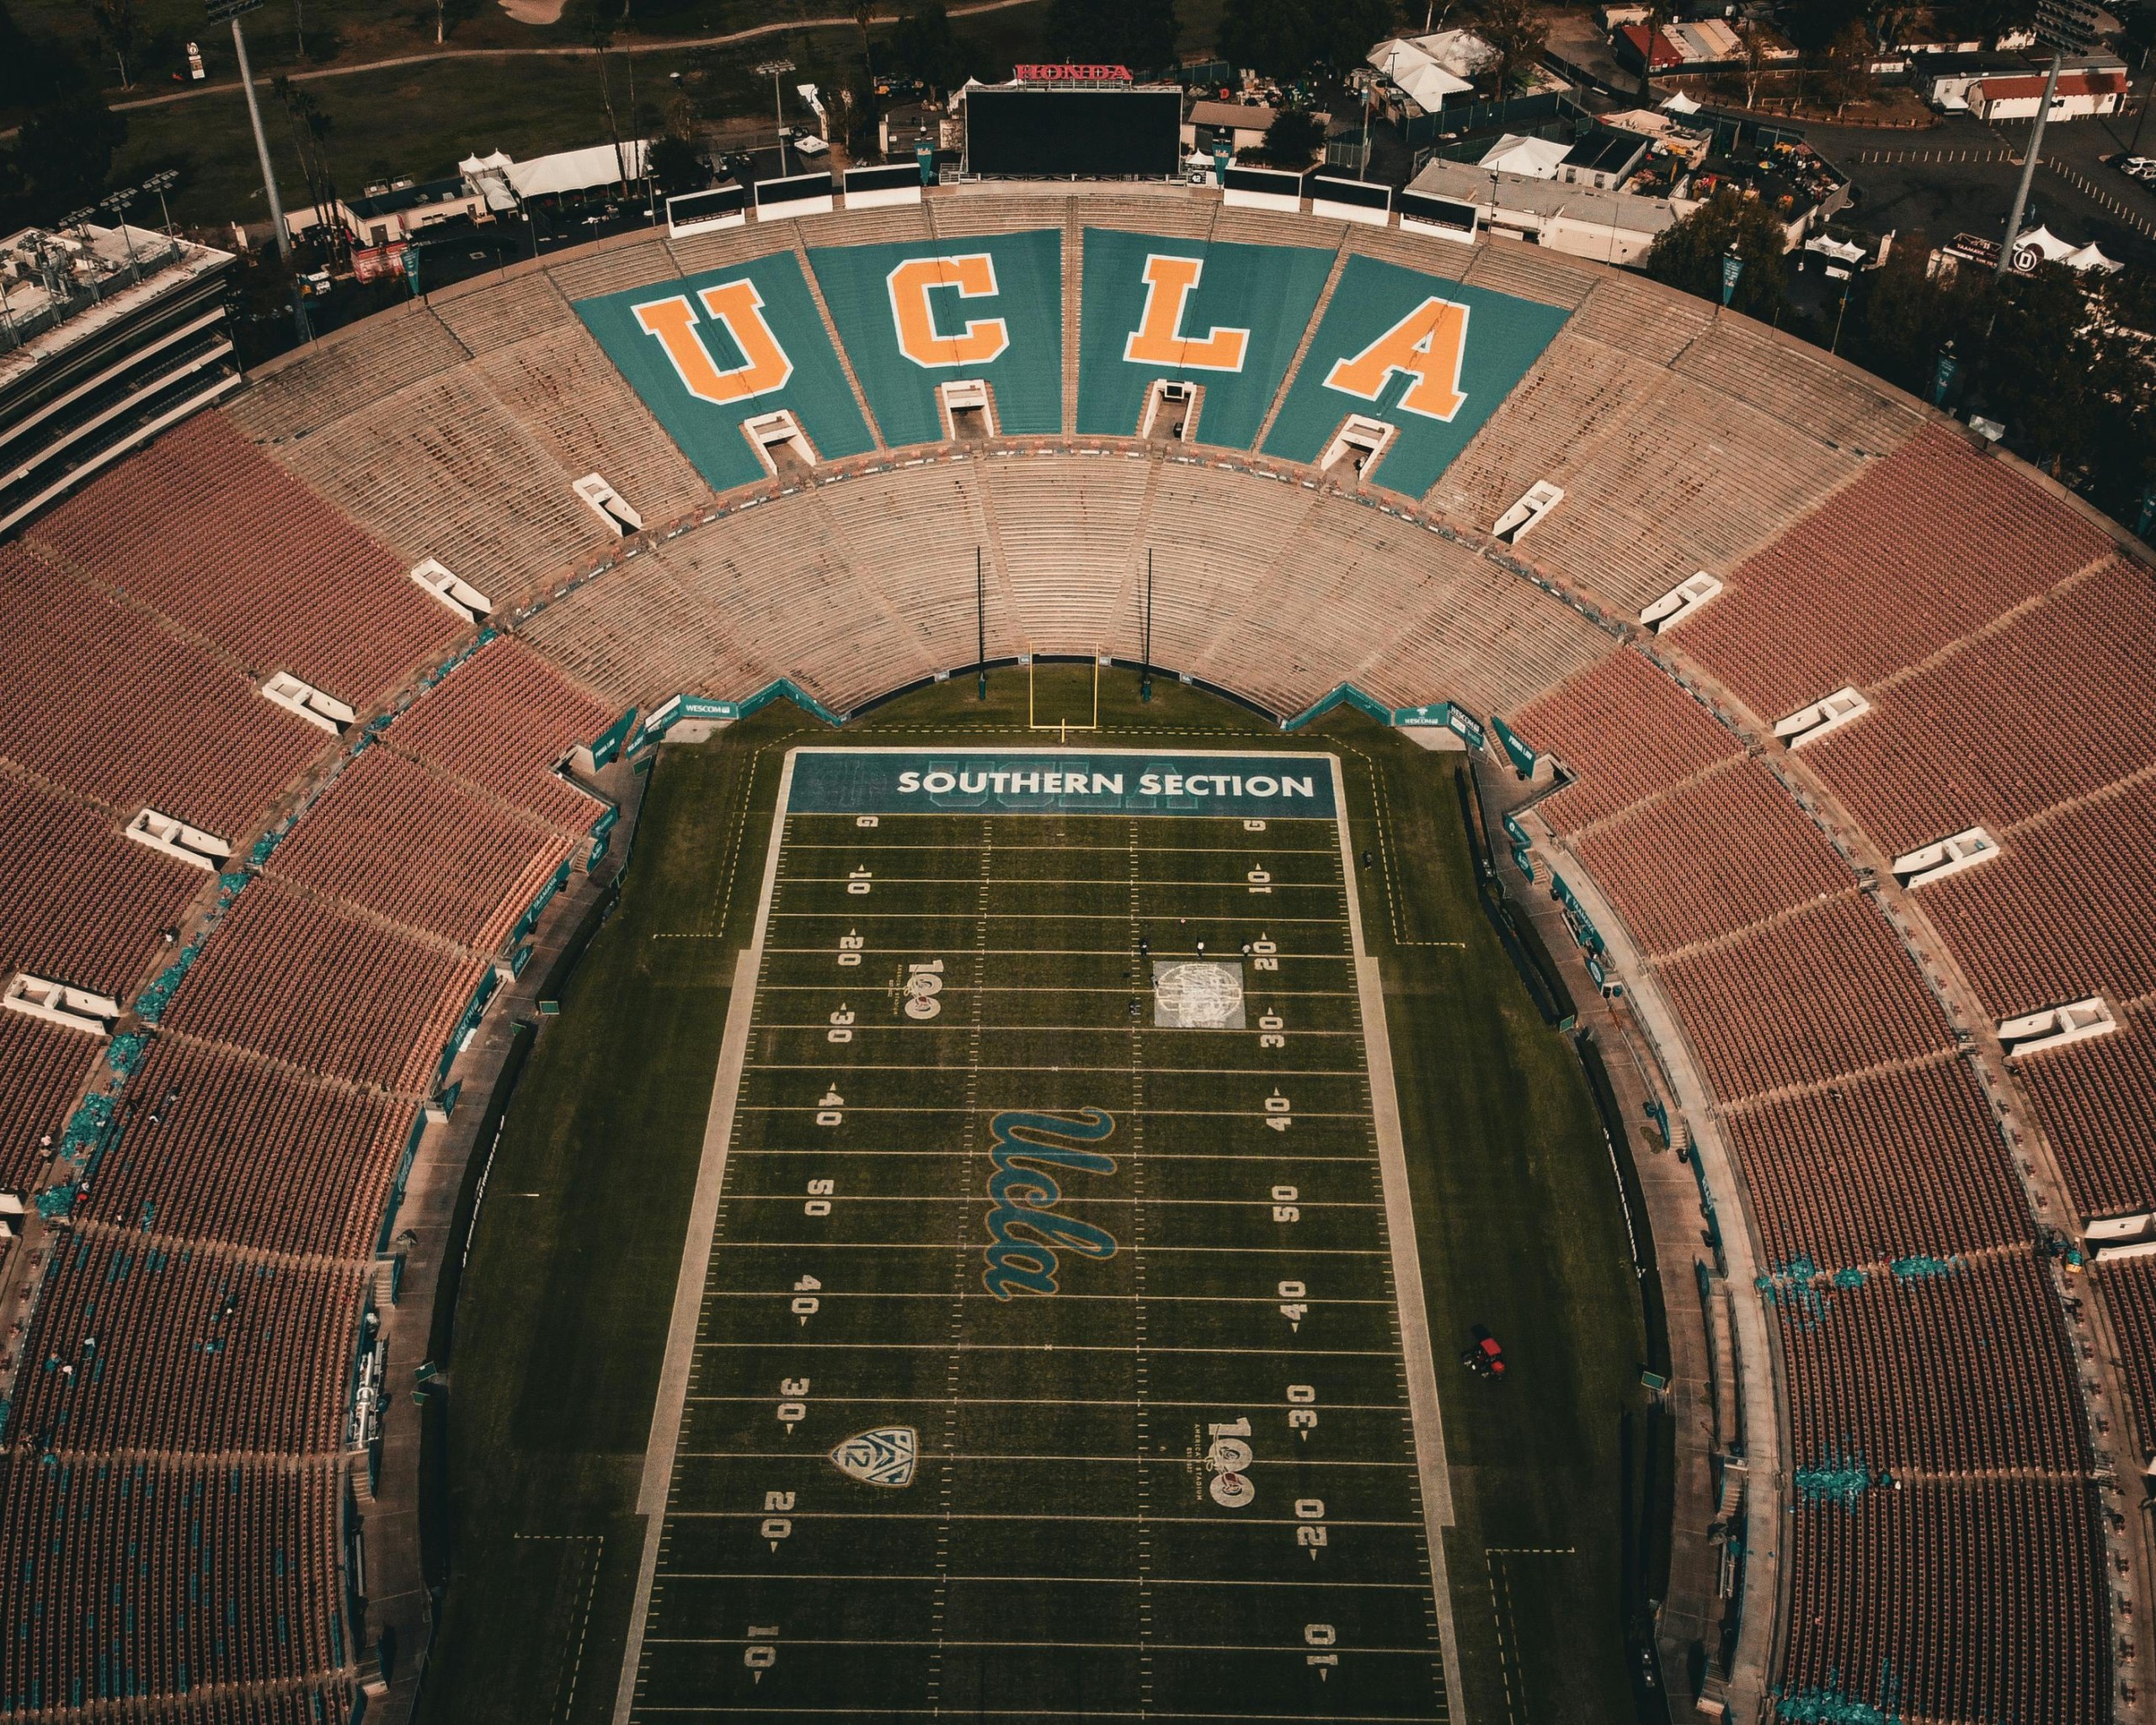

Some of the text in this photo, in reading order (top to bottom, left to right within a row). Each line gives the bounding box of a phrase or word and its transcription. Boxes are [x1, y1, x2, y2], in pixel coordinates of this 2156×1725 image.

[1015, 65, 1133, 80] HONDA
[1192, 174, 1202, 183] 42
[686, 704, 723, 714] WESCOM
[896, 771, 1315, 798] SOUTHERN SECTION
[856, 815, 879, 828] G
[1243, 820, 1267, 832] G
[847, 871, 873, 895] 10
[1247, 871, 1273, 894] 10
[837, 937, 865, 967] 20
[1252, 941, 1278, 971] 20
[905, 959, 944, 1020] 100
[827, 1012, 856, 1044] 30
[1259, 1016, 1285, 1048] 30
[816, 1092, 844, 1126] 40
[1264, 1097, 1292, 1132] 40
[804, 1179, 835, 1217] 50
[1271, 1185, 1300, 1222] 50
[791, 1274, 822, 1315] 40
[1278, 1280, 1308, 1321] 40
[776, 1378, 810, 1421] 30
[1286, 1384, 1318, 1428] 30
[845, 1445, 871, 1468] 12
[1208, 1417, 1256, 1508] 100
[760, 1491, 796, 1539] 20
[1294, 1498, 1328, 1546] 20
[744, 1626, 779, 1668] 10
[1304, 1623, 1339, 1666] 10
